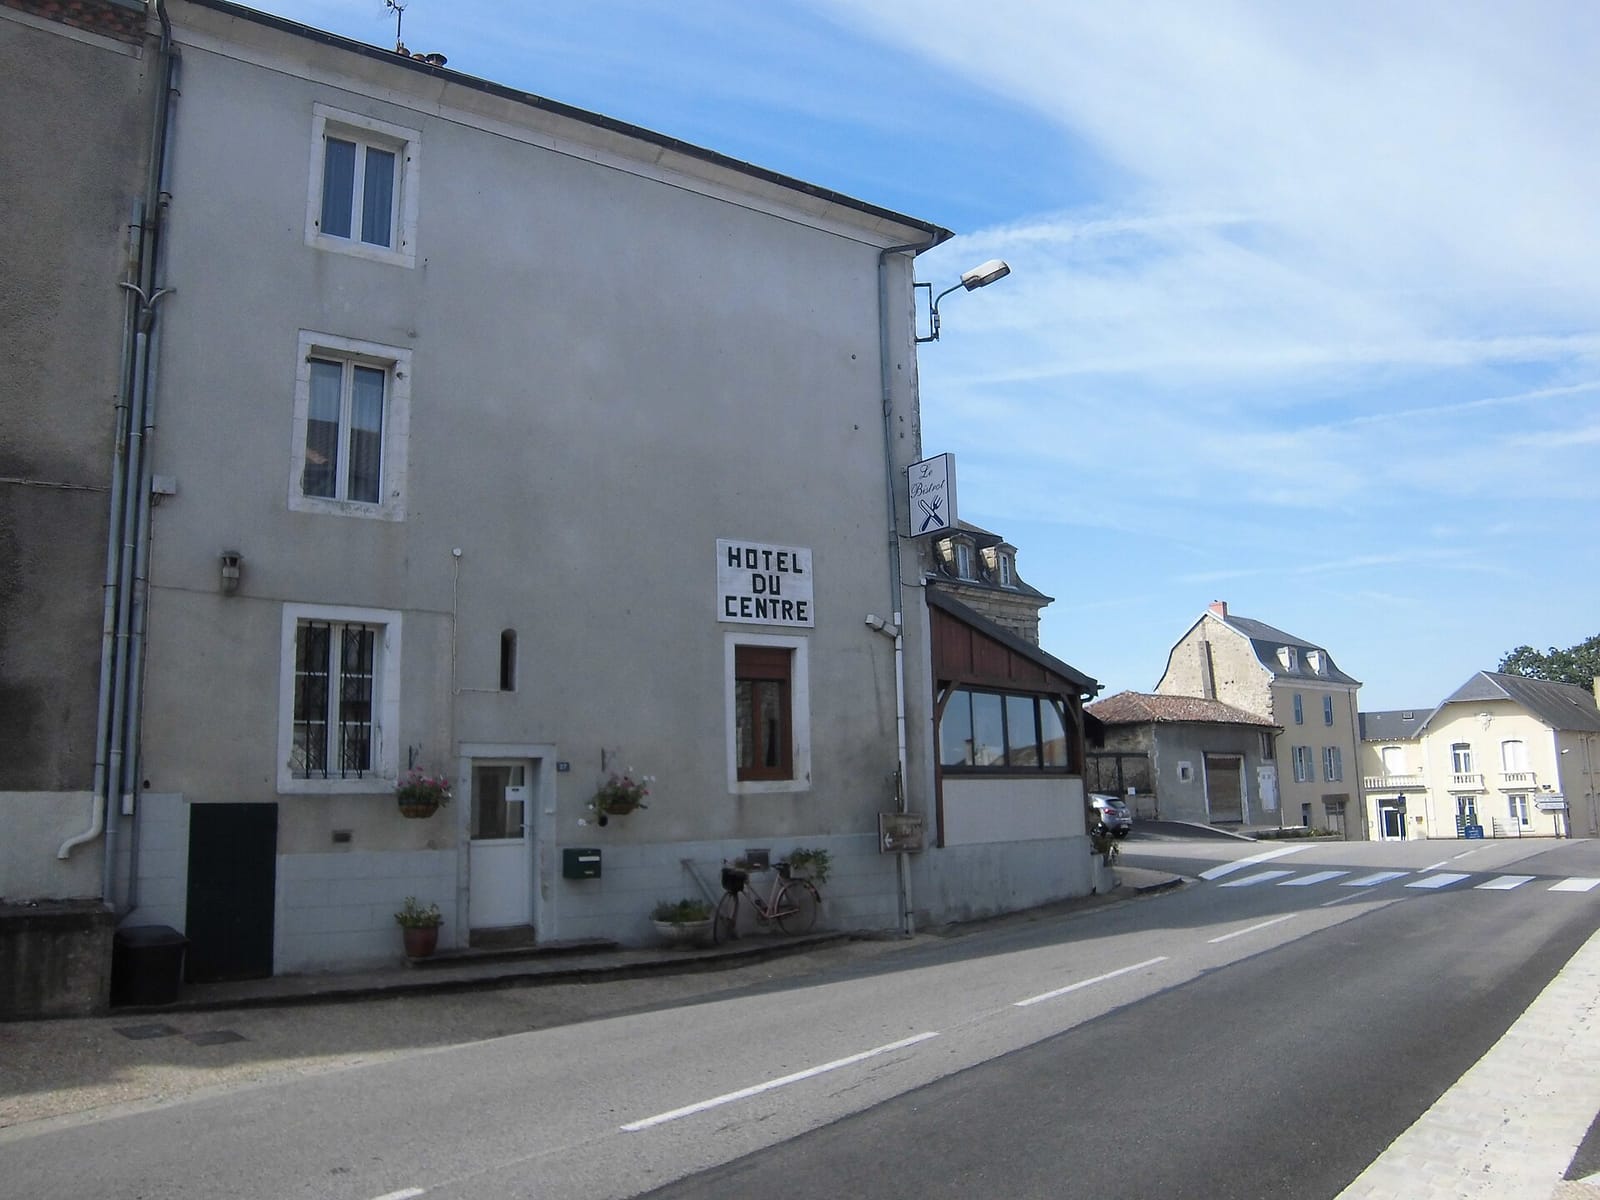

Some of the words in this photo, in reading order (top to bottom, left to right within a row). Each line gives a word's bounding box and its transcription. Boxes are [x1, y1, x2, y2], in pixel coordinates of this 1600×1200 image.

[910, 480, 945, 498] Bistrot
[728, 546, 803, 573] HOTEL
[752, 573, 780, 595] DU
[725, 595, 808, 621] CENTRE
